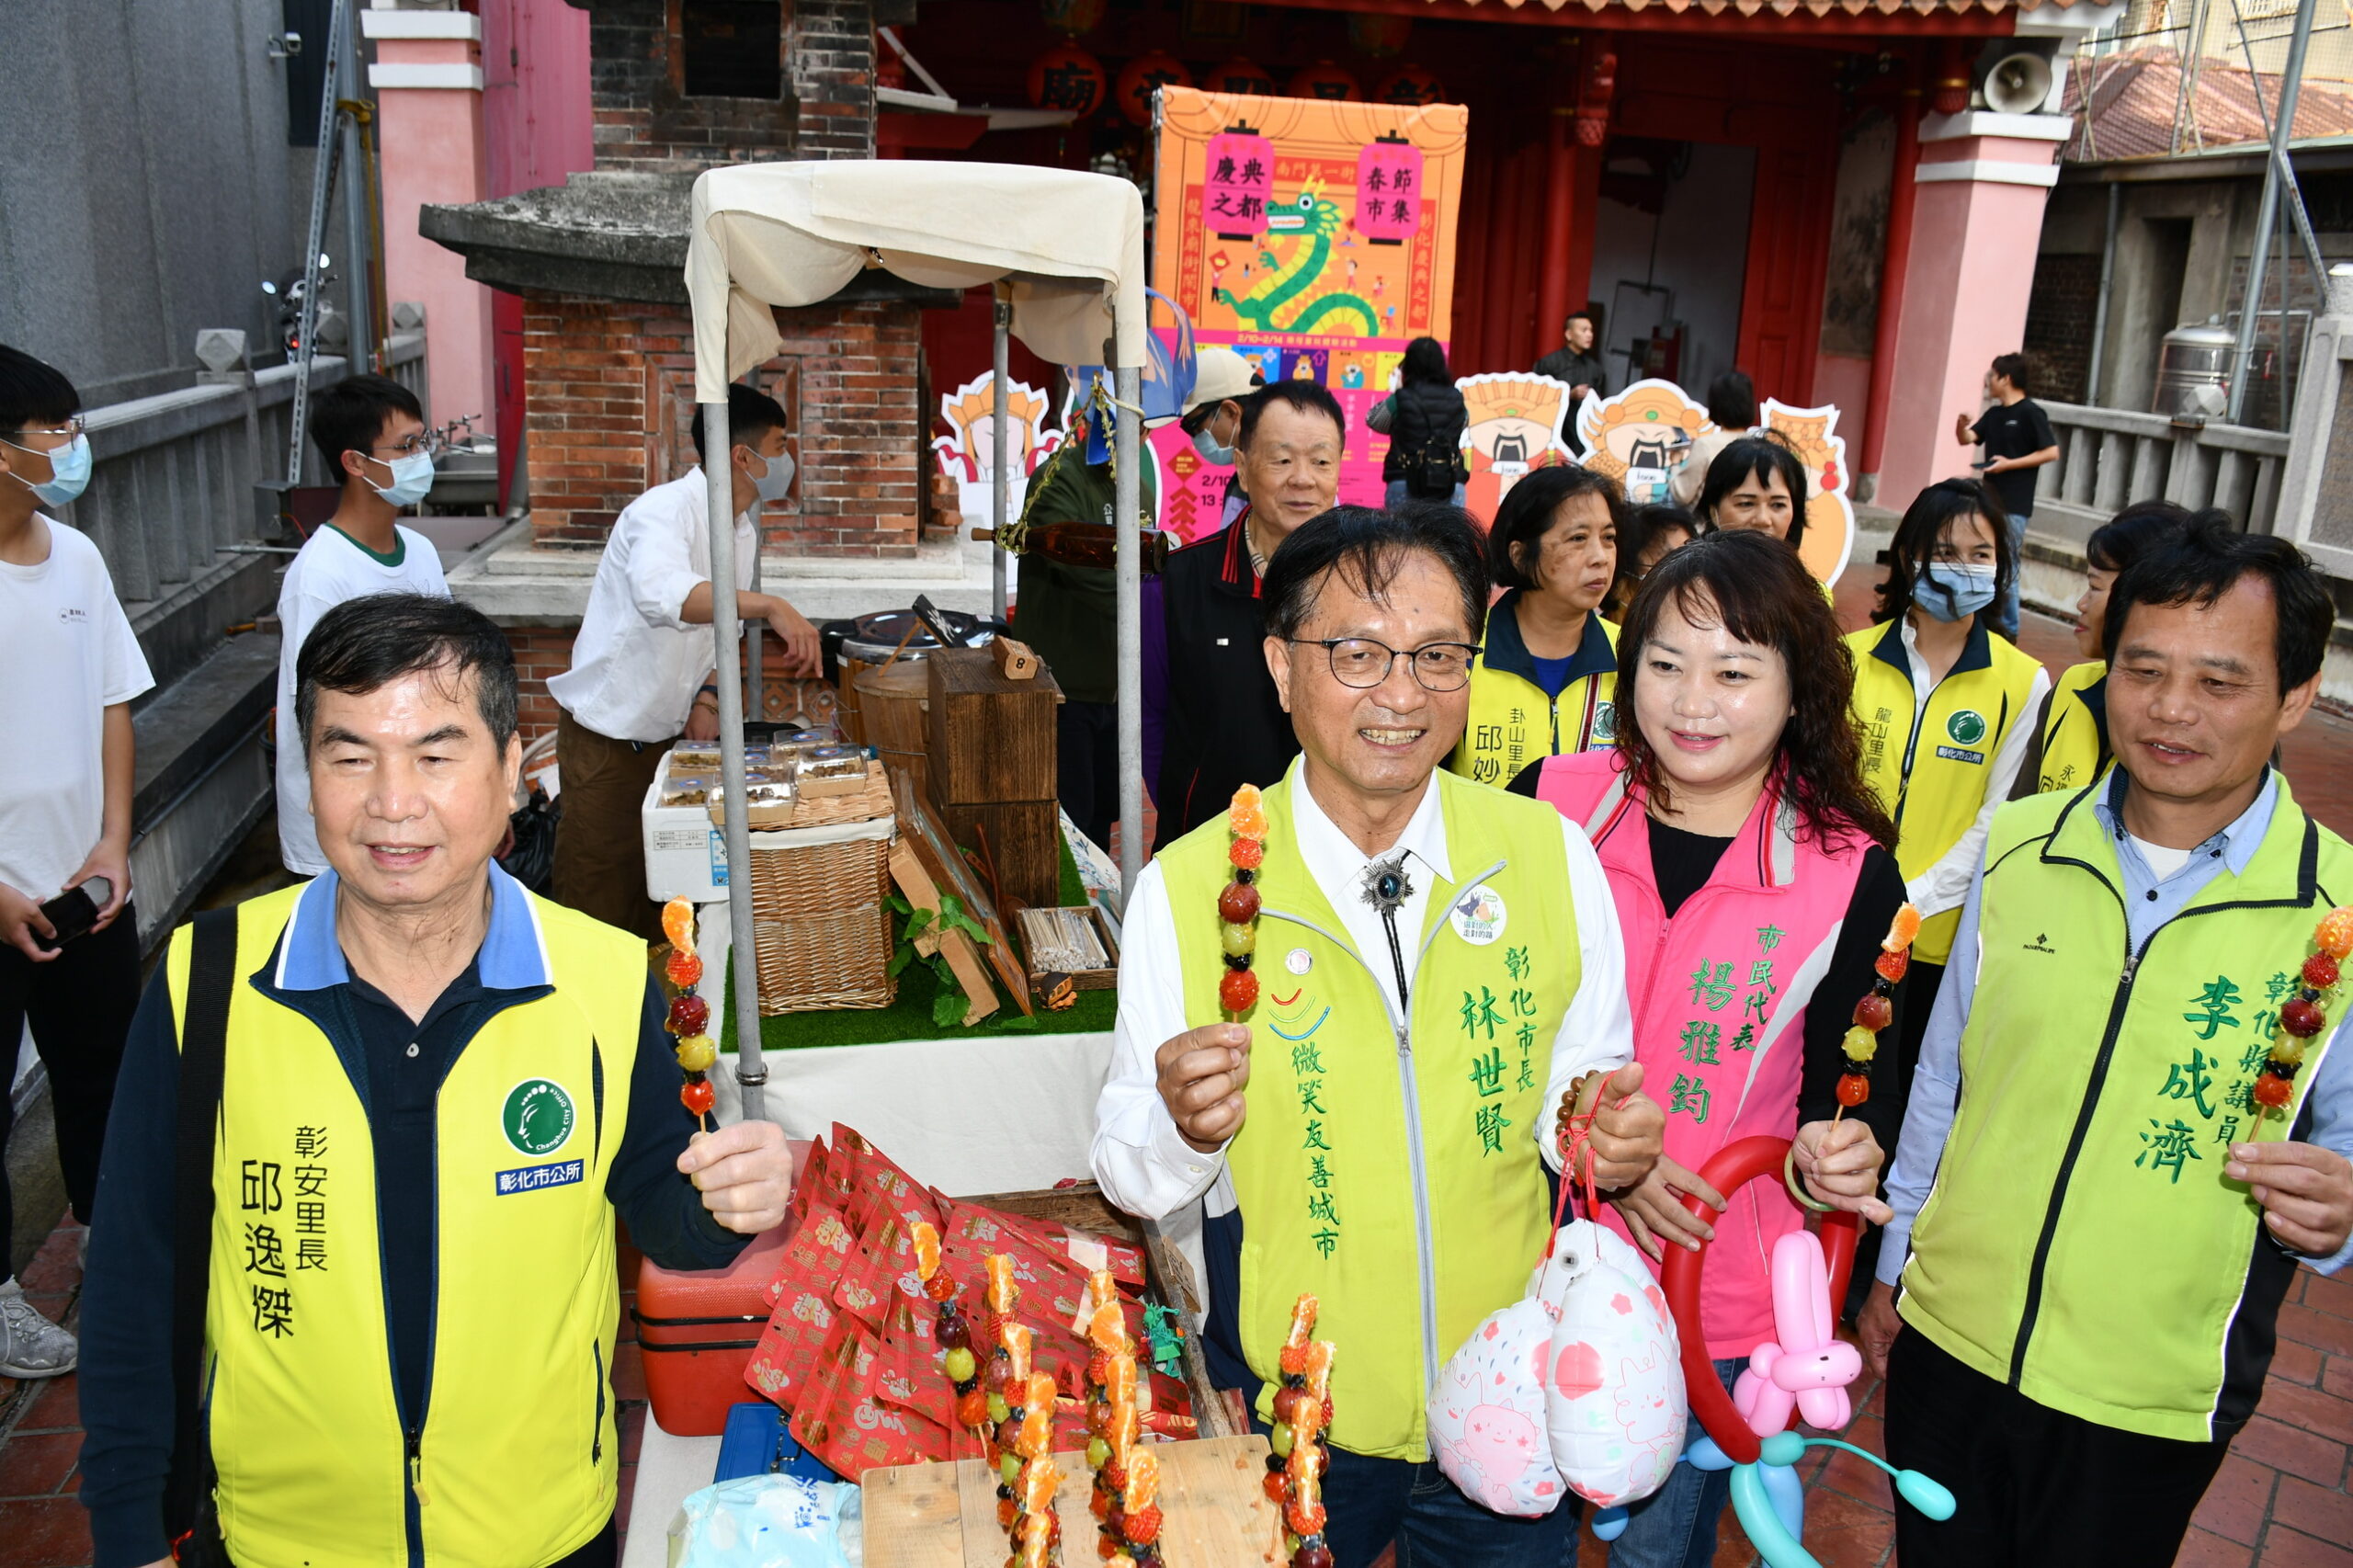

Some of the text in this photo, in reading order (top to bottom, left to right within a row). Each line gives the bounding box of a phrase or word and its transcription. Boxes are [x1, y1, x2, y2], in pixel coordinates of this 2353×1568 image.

[1210, 192, 1263, 221] 之都
[1211, 156, 1266, 185] 慶典
[1366, 166, 1413, 194] 春節
[1366, 198, 1411, 224] 市集
[1472, 724, 1503, 785] 邱妙
[1506, 707, 1527, 779] 卦山里長
[1504, 945, 1538, 1094] 彰化市長
[1730, 923, 1787, 1052] 市民代表
[1460, 985, 1512, 1159] 林世賢
[2133, 975, 2244, 1185] 李成濟
[294, 1125, 329, 1273] 彰安里長
[499, 1162, 581, 1192] 彰化市公所
[1291, 1041, 1341, 1261] 微笑友善城市
[241, 1158, 295, 1340] 邱逸傑
